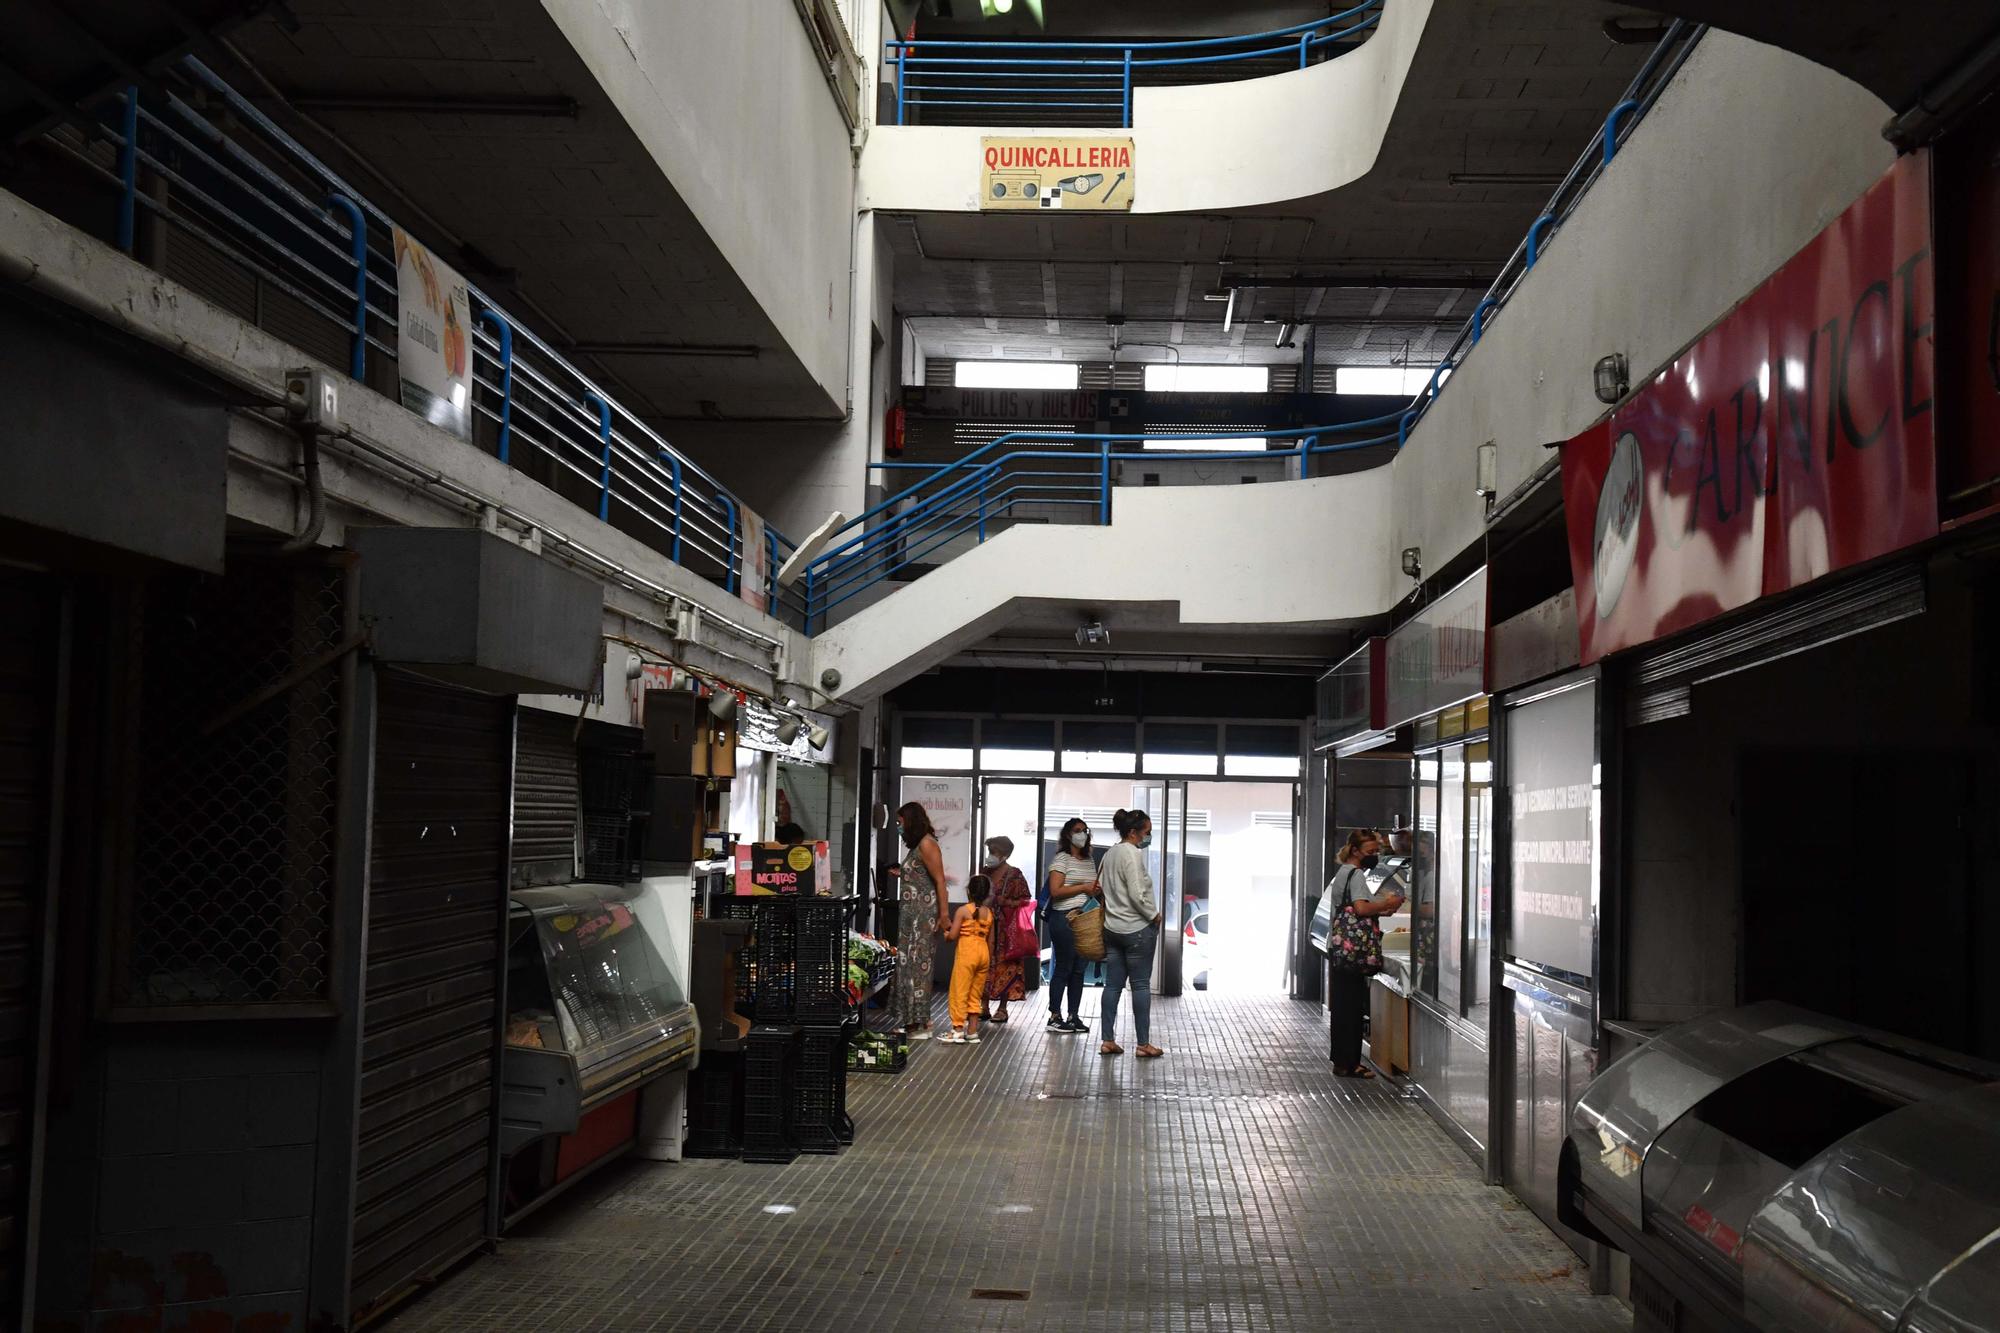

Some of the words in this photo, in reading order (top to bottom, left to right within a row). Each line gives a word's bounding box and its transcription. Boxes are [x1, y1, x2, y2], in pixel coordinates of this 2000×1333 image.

[985, 147, 1130, 170] QUINCALLERIA
[962, 391, 1018, 417] POLLOS
[1041, 392, 1097, 418] HUEVOS
